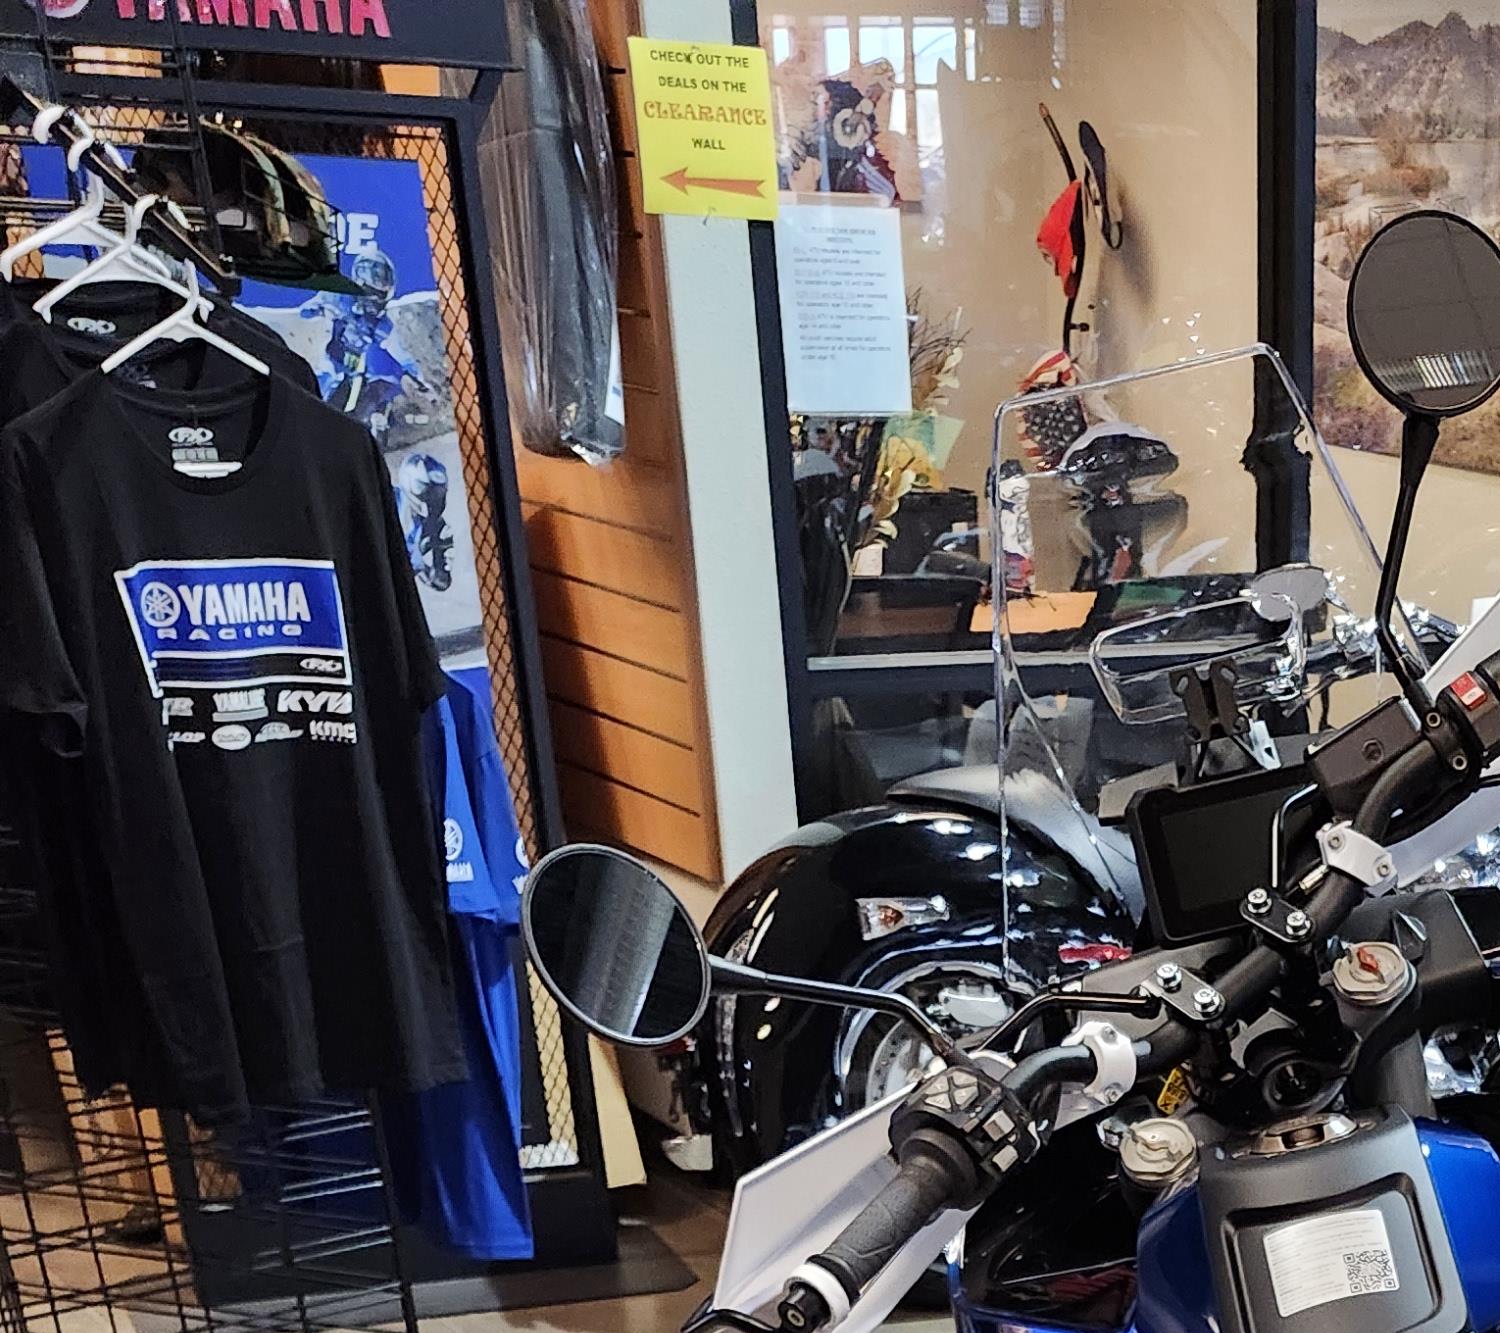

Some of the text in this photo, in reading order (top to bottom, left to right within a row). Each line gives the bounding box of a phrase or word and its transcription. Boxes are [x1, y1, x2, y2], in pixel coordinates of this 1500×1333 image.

[650, 50, 749, 68] CHECK OUT THE
[658, 76, 747, 93] DEALS ON THE
[643, 100, 767, 126] CLEARANCE
[692, 138, 726, 151] WALL
[177, 581, 311, 625] YAMAHA
[156, 624, 303, 641] RACING
